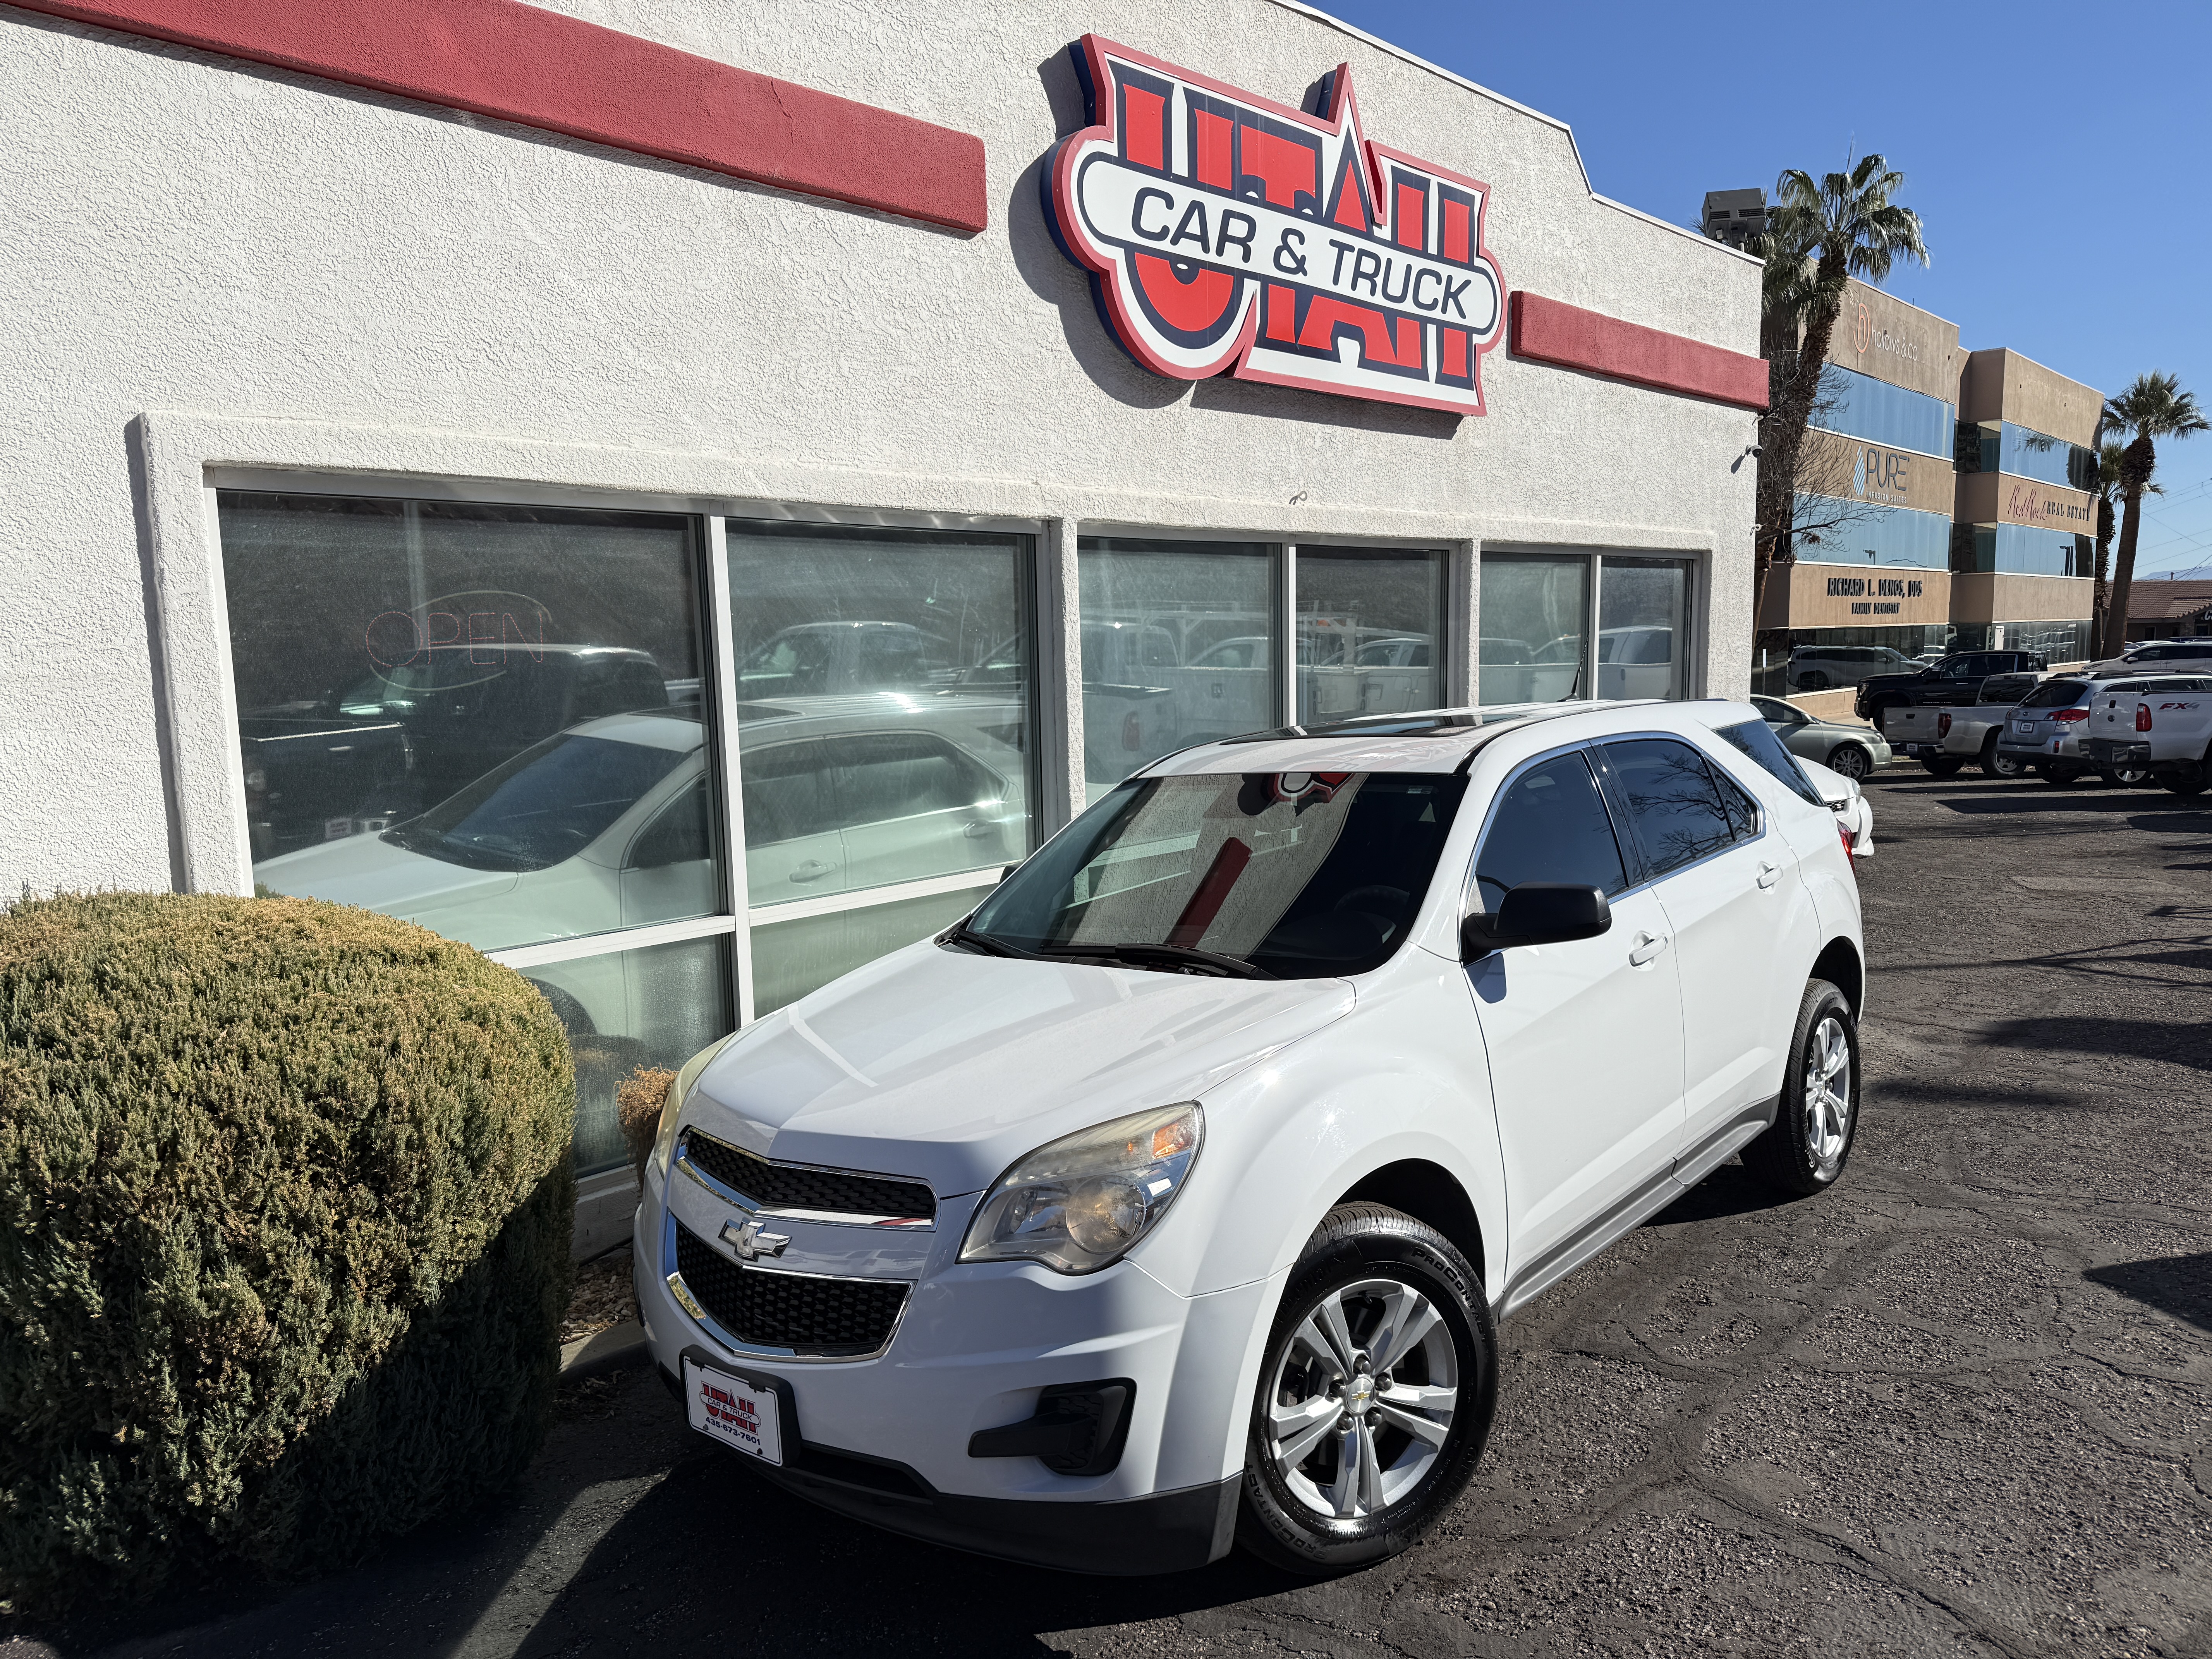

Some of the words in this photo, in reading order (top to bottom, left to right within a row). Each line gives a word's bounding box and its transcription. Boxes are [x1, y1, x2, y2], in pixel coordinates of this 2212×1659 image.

[1132, 187, 1257, 264] CAR
[1273, 227, 1308, 276] &
[1328, 238, 1472, 319] TRUCK
[1871, 323, 1899, 355] hallows
[1901, 337, 1907, 359] &
[1866, 448, 1909, 491] PURE
[1866, 490, 1889, 501] INFUSION
[1891, 494, 1906, 503] SUITES
[2047, 500, 2064, 517] REAL
[2067, 505, 2090, 521] ESTATE
[1827, 577, 1865, 597] RICHARD
[1867, 579, 1875, 597] L.
[1878, 579, 1905, 599] DENOS,
[1908, 580, 1923, 598] DDS
[1851, 602, 1872, 615] FAMILY
[1873, 602, 1901, 615] DENTISTRY
[2204, 609, 2212, 620] C
[366, 611, 543, 667] OPEN
[2159, 702, 2200, 710] FX4
[708, 1398, 721, 1408] CAR
[729, 1407, 752, 1421] TRUCK
